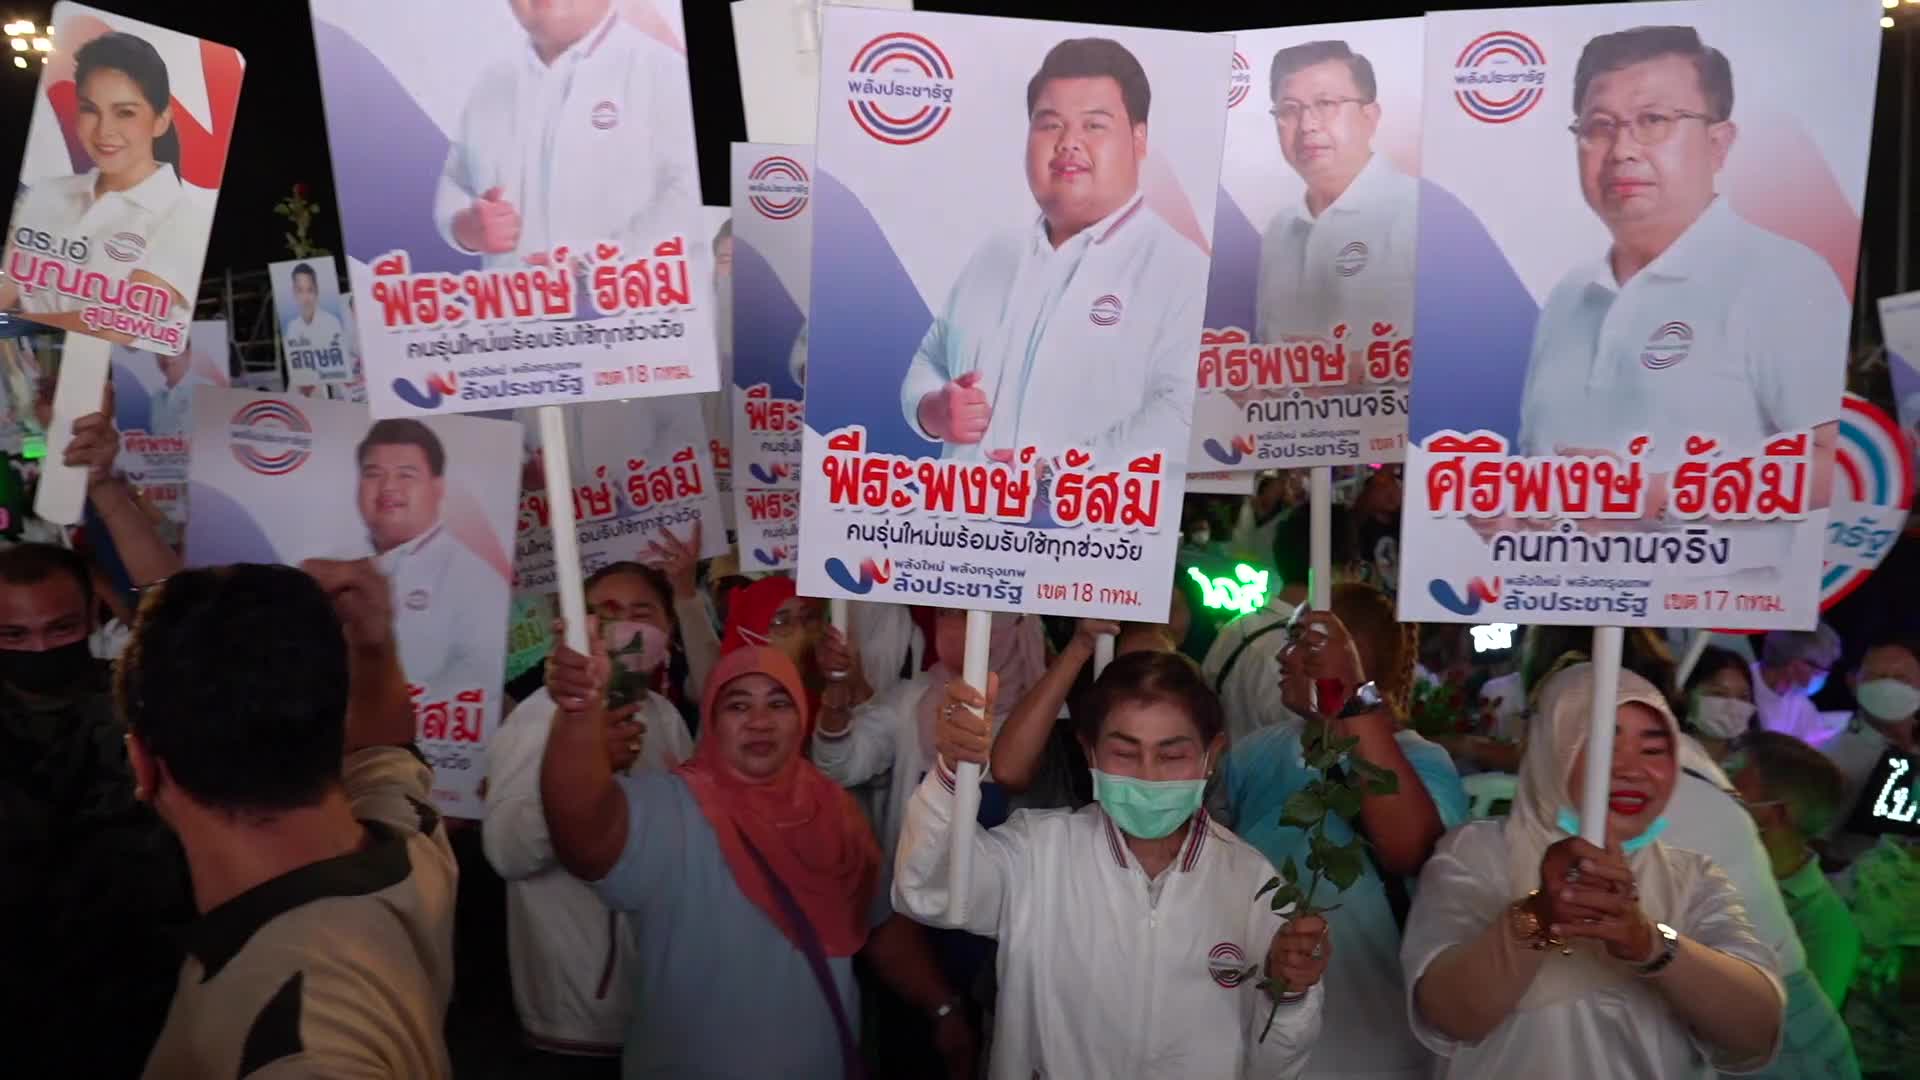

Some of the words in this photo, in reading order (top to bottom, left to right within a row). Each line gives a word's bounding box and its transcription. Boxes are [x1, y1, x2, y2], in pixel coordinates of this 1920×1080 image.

[848, 79, 953, 103] พลังประชารัฐ
[372, 244, 573, 328] พีระพงษ์
[592, 235, 692, 313] รัสมี
[822, 430, 1037, 518] พีระพงษ์
[1054, 447, 1162, 528] รัสมี
[1427, 434, 1650, 514] ศิริพงษ์
[1672, 433, 1808, 515] รัสมี
[846, 519, 1143, 562] คนรุ่นใหม่พร้อมรับใช้ทุกช่วงวัย
[1491, 523, 1731, 565] คนทำงานจริง
[894, 558, 945, 573] พลังใหม่
[1037, 582, 1067, 601] เขต
[1071, 582, 1093, 603] 18
[1099, 587, 1143, 606] กทม.
[1704, 589, 1731, 611] 17
